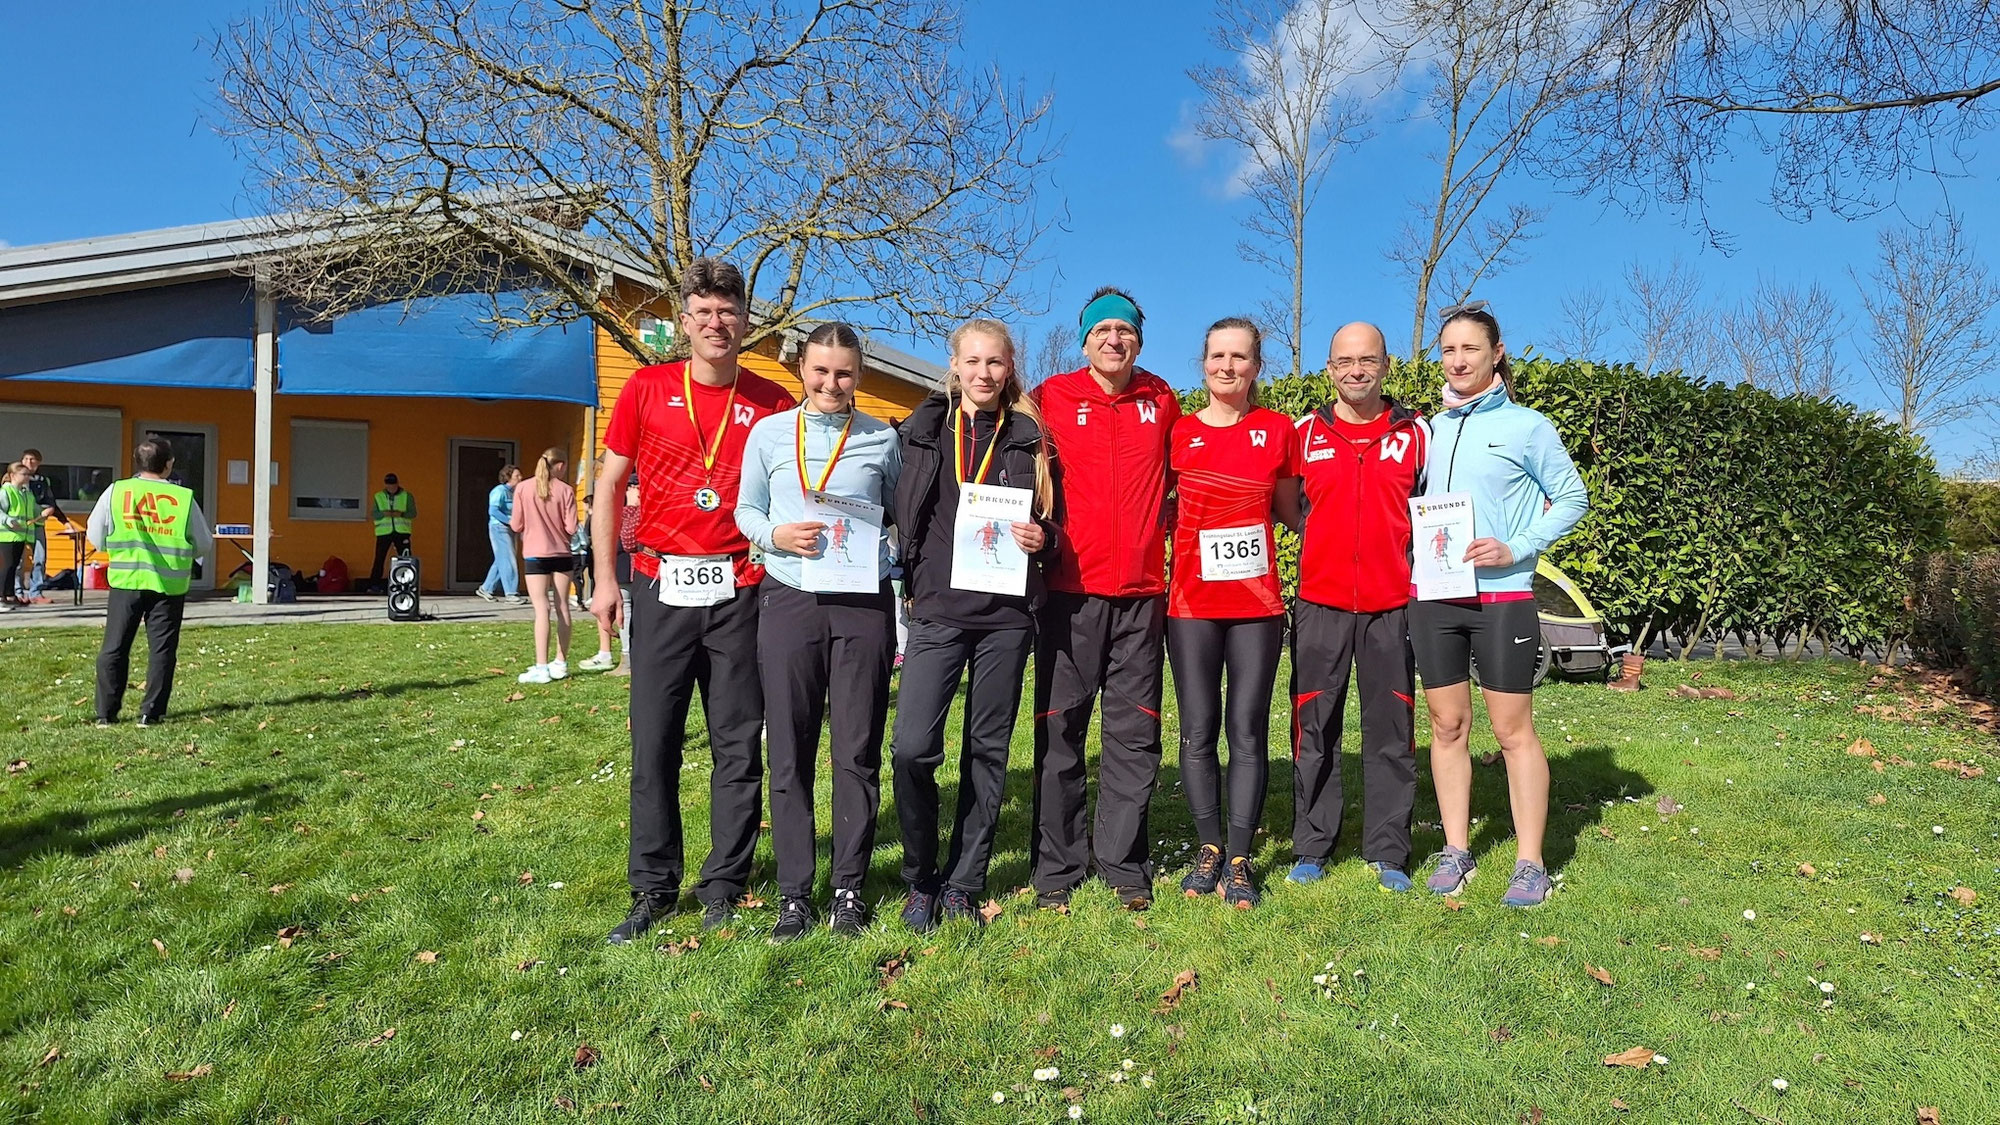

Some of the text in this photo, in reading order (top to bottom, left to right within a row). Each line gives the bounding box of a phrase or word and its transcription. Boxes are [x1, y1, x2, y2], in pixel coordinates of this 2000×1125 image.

[123, 491, 178, 524] LAC
[827, 498, 876, 511] URKUNDE
[980, 495, 1024, 506] URKUNDE
[1427, 501, 1466, 511] URKUNDE
[1211, 538, 1260, 560] 1365
[672, 566, 725, 586] 1368
